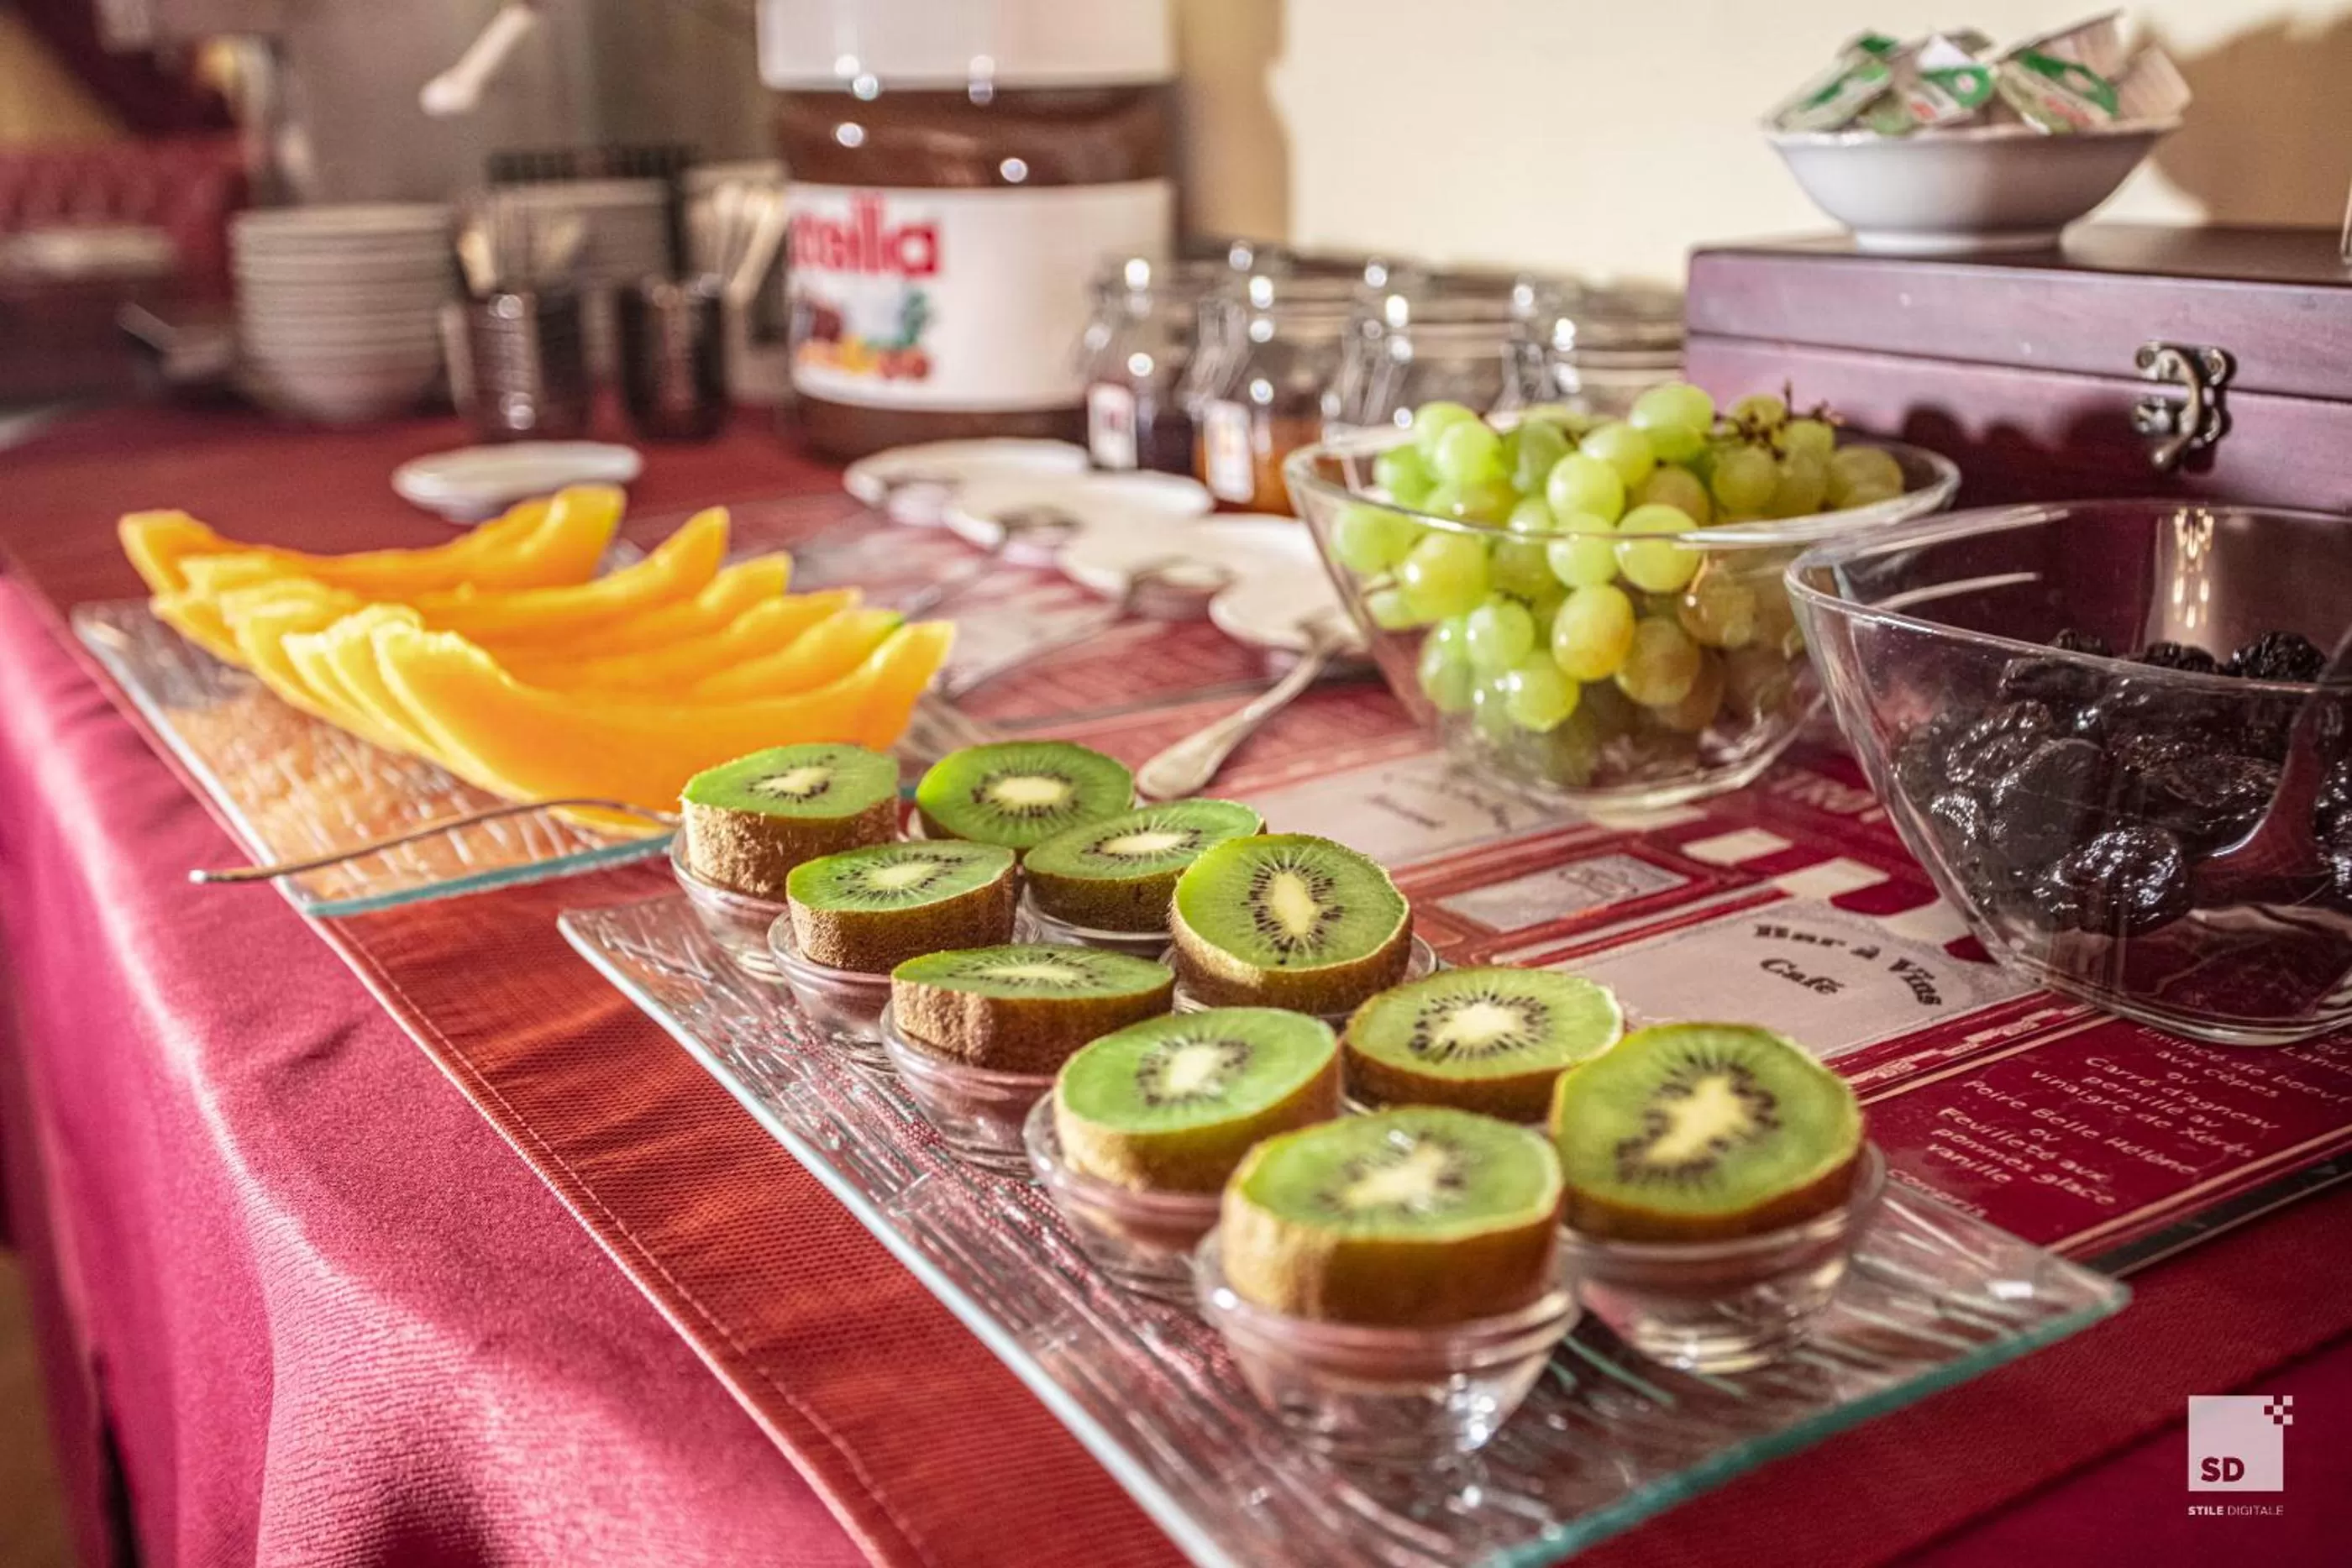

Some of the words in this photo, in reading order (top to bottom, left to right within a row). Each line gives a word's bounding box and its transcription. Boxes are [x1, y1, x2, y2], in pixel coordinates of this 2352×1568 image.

[1754, 924, 1846, 947] Bar
[1888, 957, 1942, 1006] Vins
[1760, 958, 1845, 995] Café
[2085, 1057, 2158, 1088] Carré
[2231, 1062, 2266, 1076] de
[1962, 1080, 2029, 1110] Poire
[2029, 1108, 2100, 1140] Belle
[2030, 1070, 2132, 1114] vinaigre
[2134, 1112, 2173, 1129] de
[1926, 1143, 2014, 1184] vanille
[1929, 1128, 2035, 1173] pommes
[2029, 1172, 2116, 1204] glace
